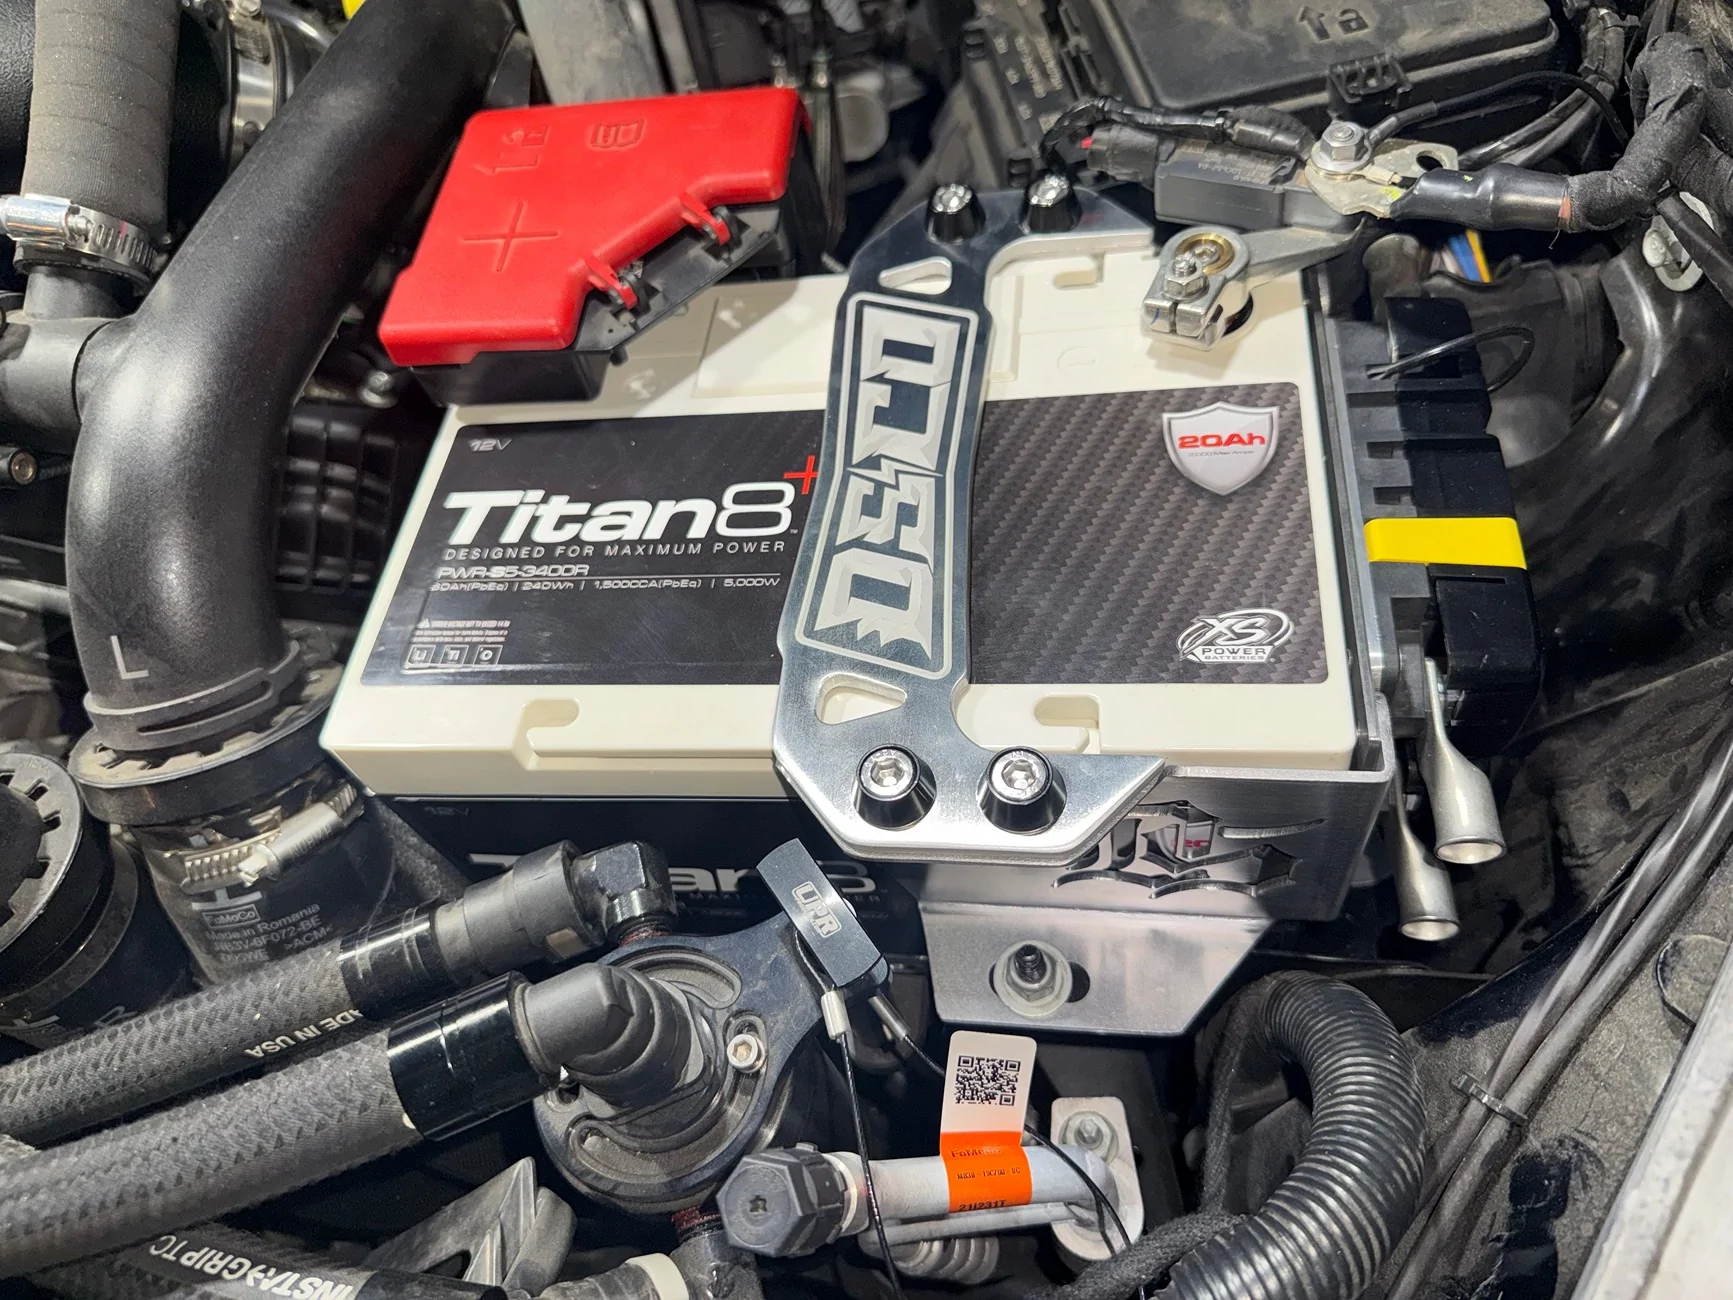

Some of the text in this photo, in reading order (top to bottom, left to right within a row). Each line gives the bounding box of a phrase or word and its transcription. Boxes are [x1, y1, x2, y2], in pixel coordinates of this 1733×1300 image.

[468, 438, 512, 452] 12V
[1178, 433, 1266, 449] 20Ah
[444, 541, 785, 561] DESIGNED FOR MAXIMUM POWER
[522, 580, 575, 591] 240Wh
[724, 577, 780, 588] 5,000W
[1182, 616, 1268, 654] XS
[1202, 647, 1267, 656] POWER
[207, 910, 257, 925] FoMoCo
[256, 903, 322, 933] Romania
[795, 883, 840, 935] UPR
[294, 1025, 322, 1041] IN
[244, 1035, 296, 1058] USA
[149, 1234, 188, 1261] TC
